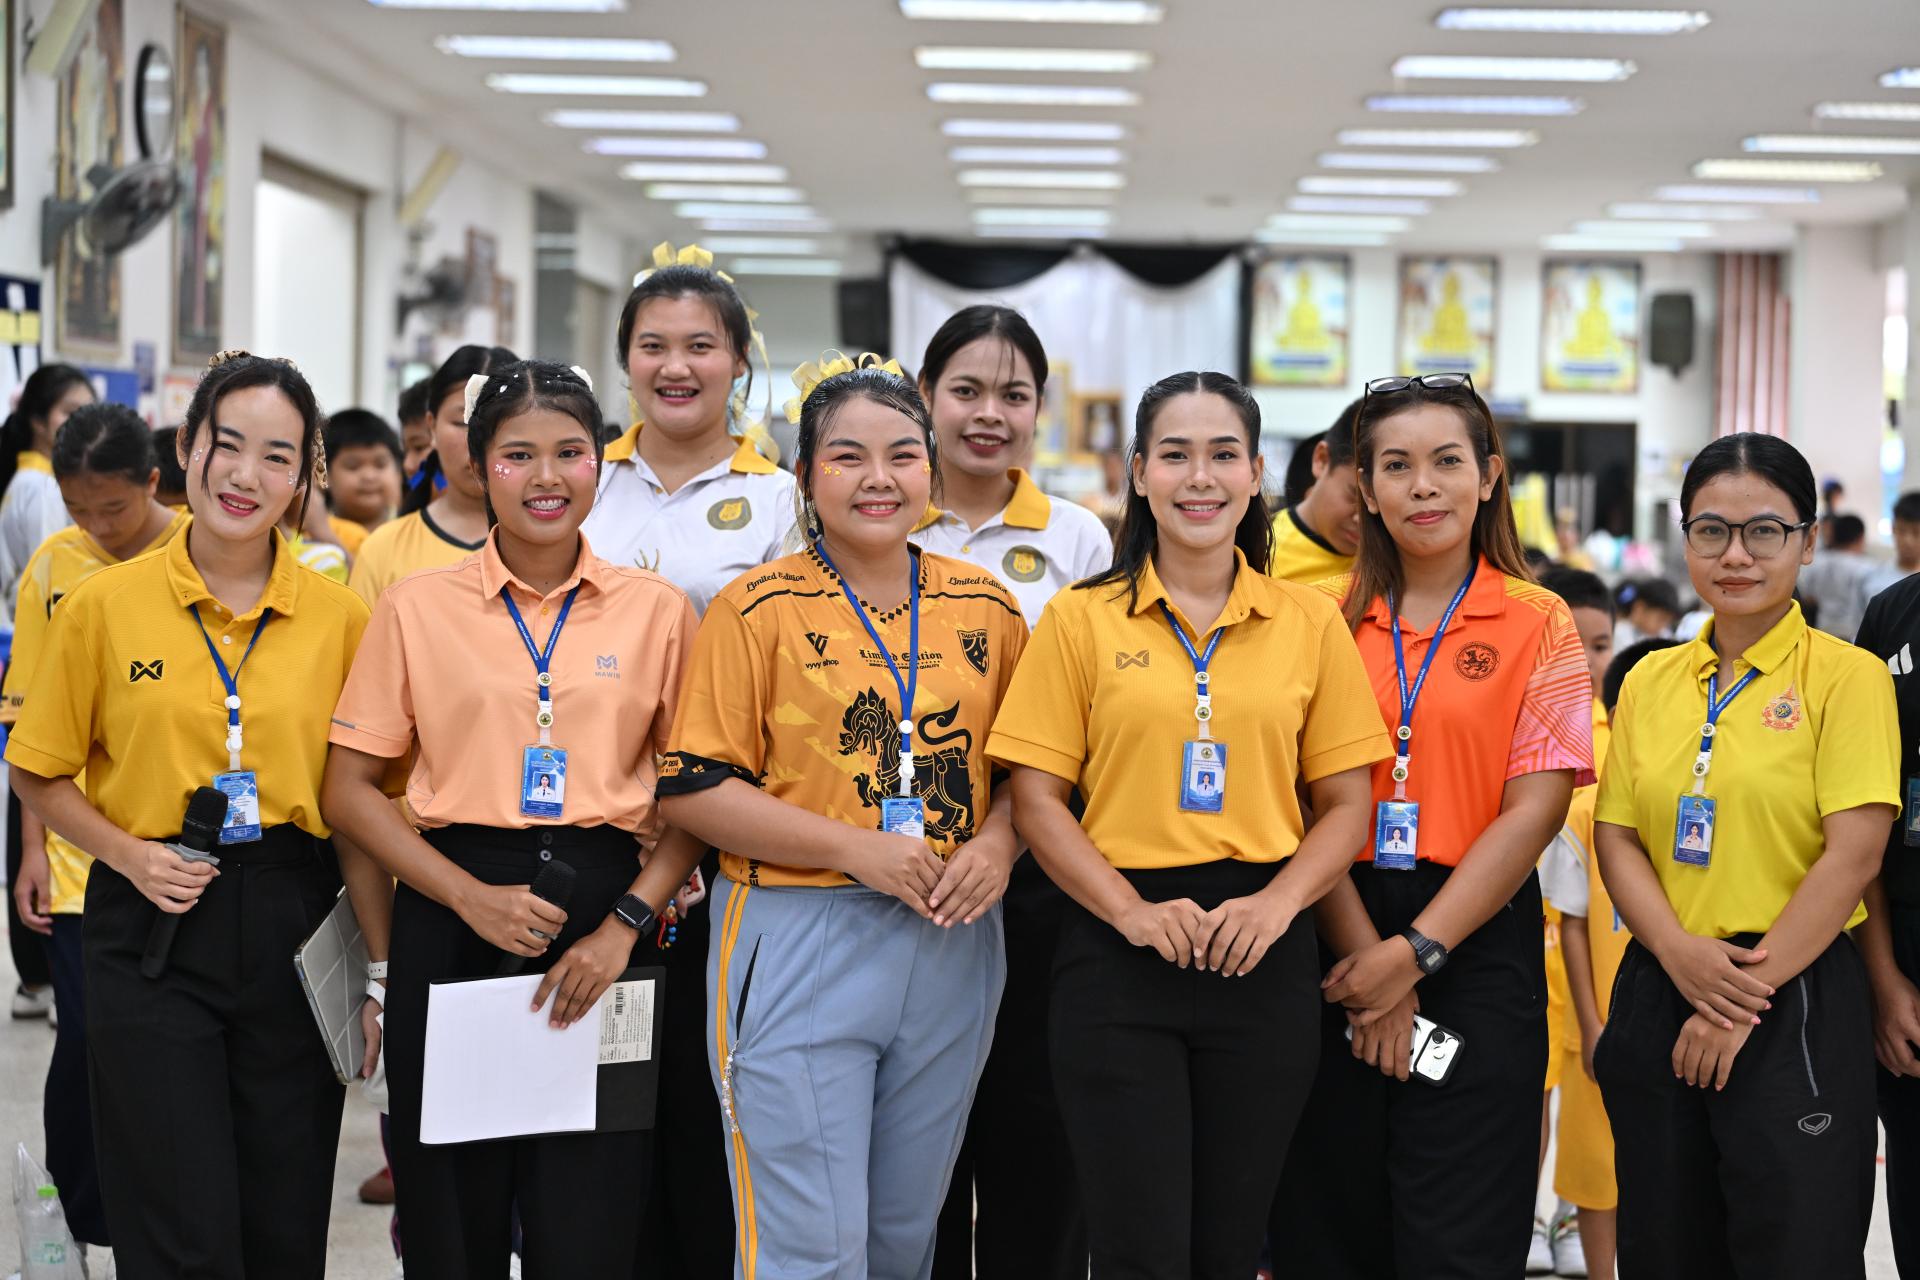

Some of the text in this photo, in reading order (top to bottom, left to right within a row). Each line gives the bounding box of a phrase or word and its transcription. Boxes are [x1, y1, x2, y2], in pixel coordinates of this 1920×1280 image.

[746, 572, 777, 593] Limited
[947, 577, 1008, 594] Limited Edition
[859, 649, 943, 661] Limid Etion
[823, 659, 839, 667] shop
